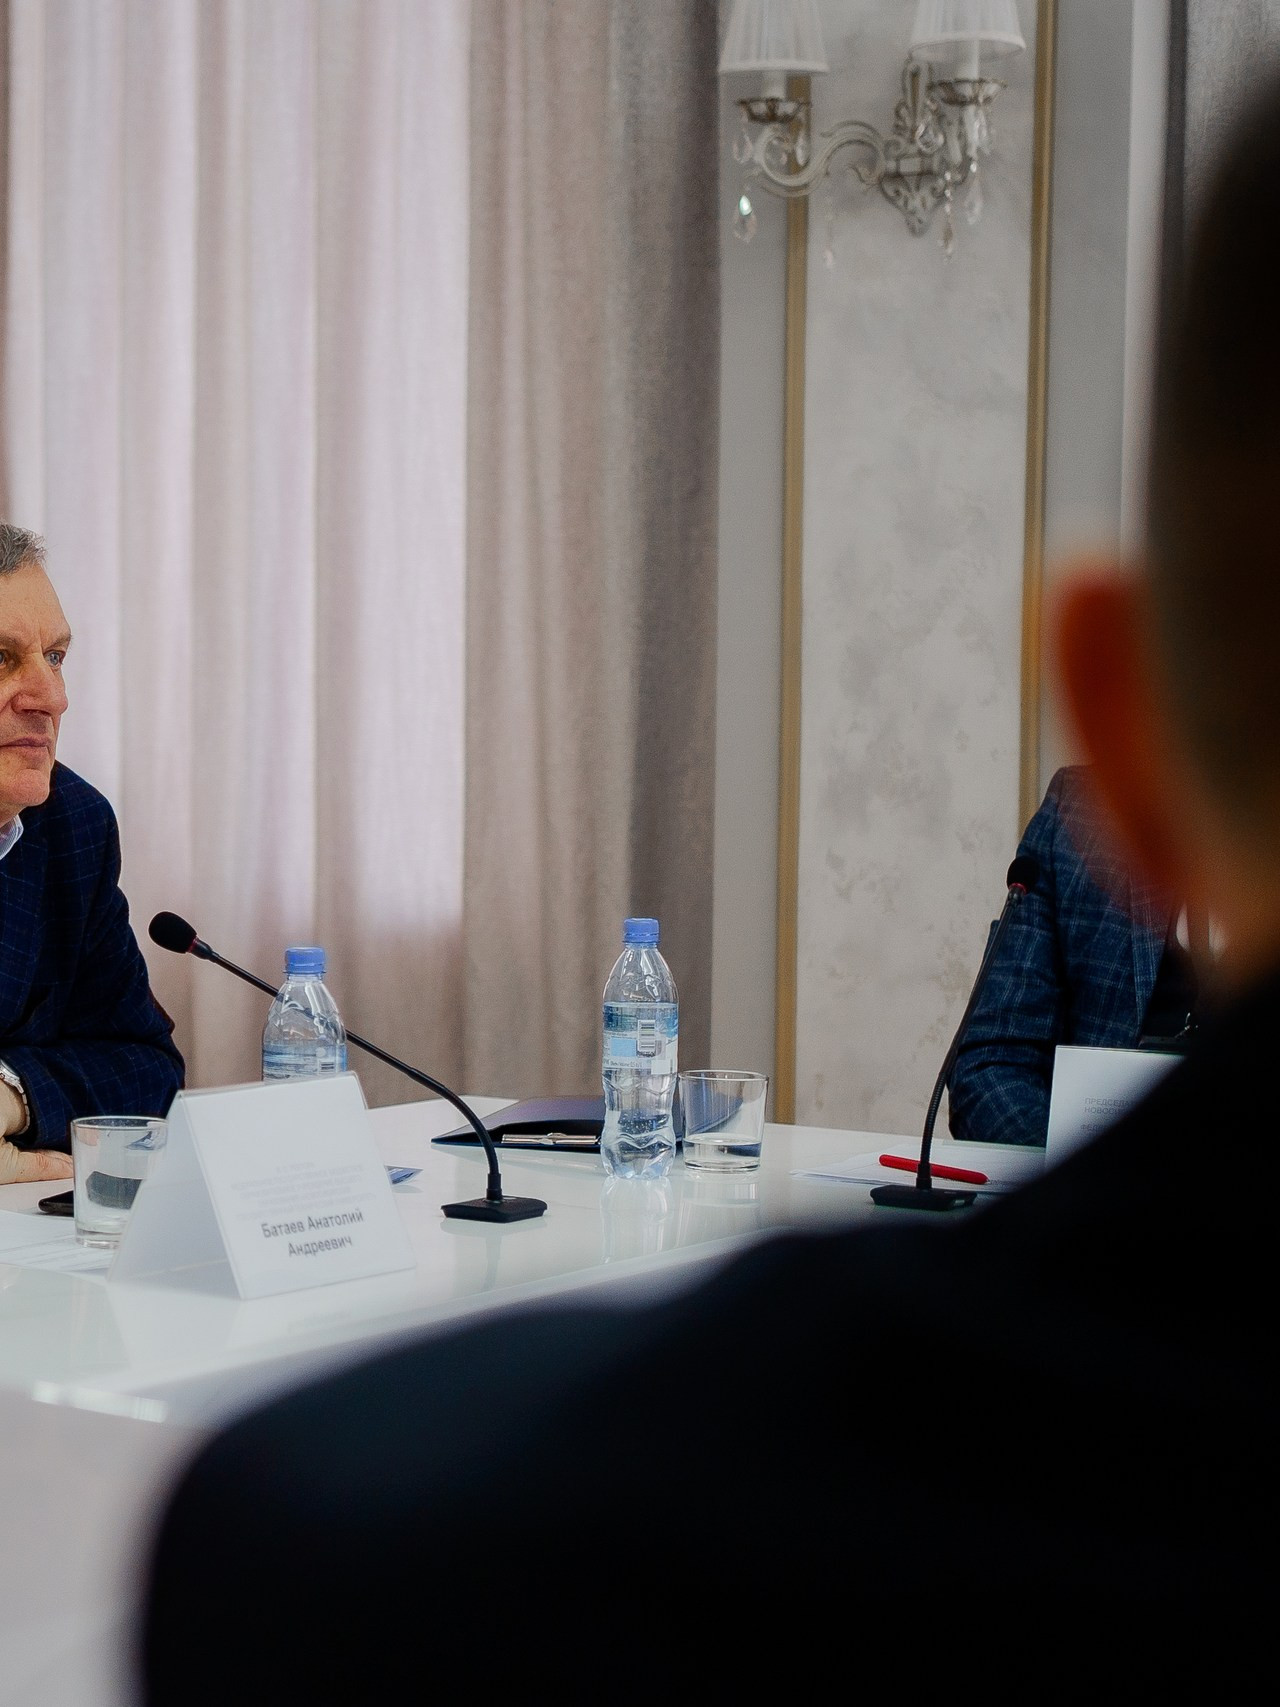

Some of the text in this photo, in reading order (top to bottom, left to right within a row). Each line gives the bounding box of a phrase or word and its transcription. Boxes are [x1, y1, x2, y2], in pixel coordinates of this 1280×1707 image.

[261, 1208, 364, 1238] Батаев Анатолий
[287, 1236, 352, 1258] Андреевич
